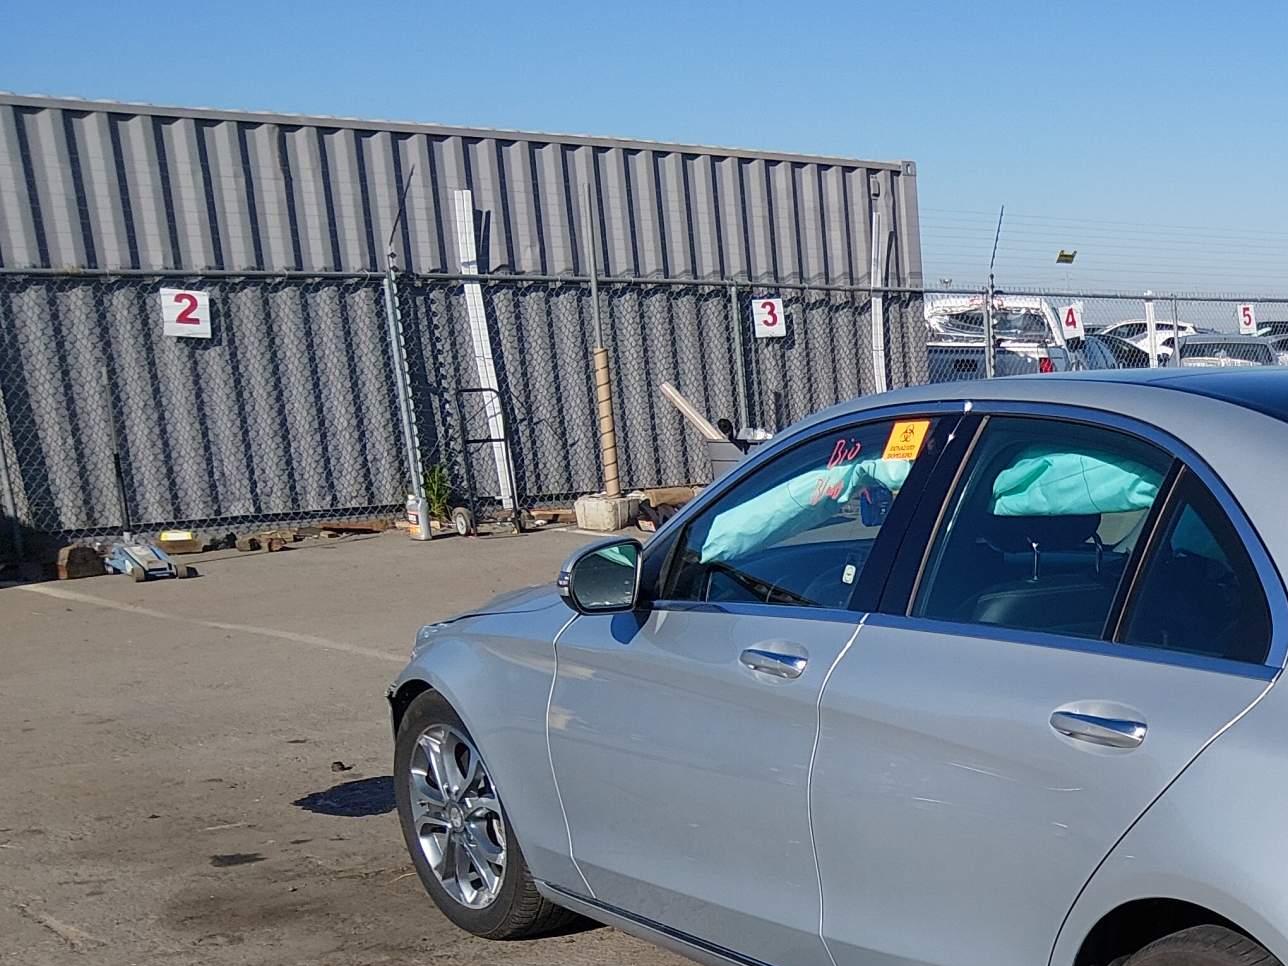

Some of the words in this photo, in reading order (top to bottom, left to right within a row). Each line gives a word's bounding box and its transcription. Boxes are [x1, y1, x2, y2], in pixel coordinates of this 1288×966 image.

[174, 293, 200, 325] 2
[761, 301, 778, 327] 3
[1064, 307, 1077, 329] 4
[1242, 307, 1252, 326] 5
